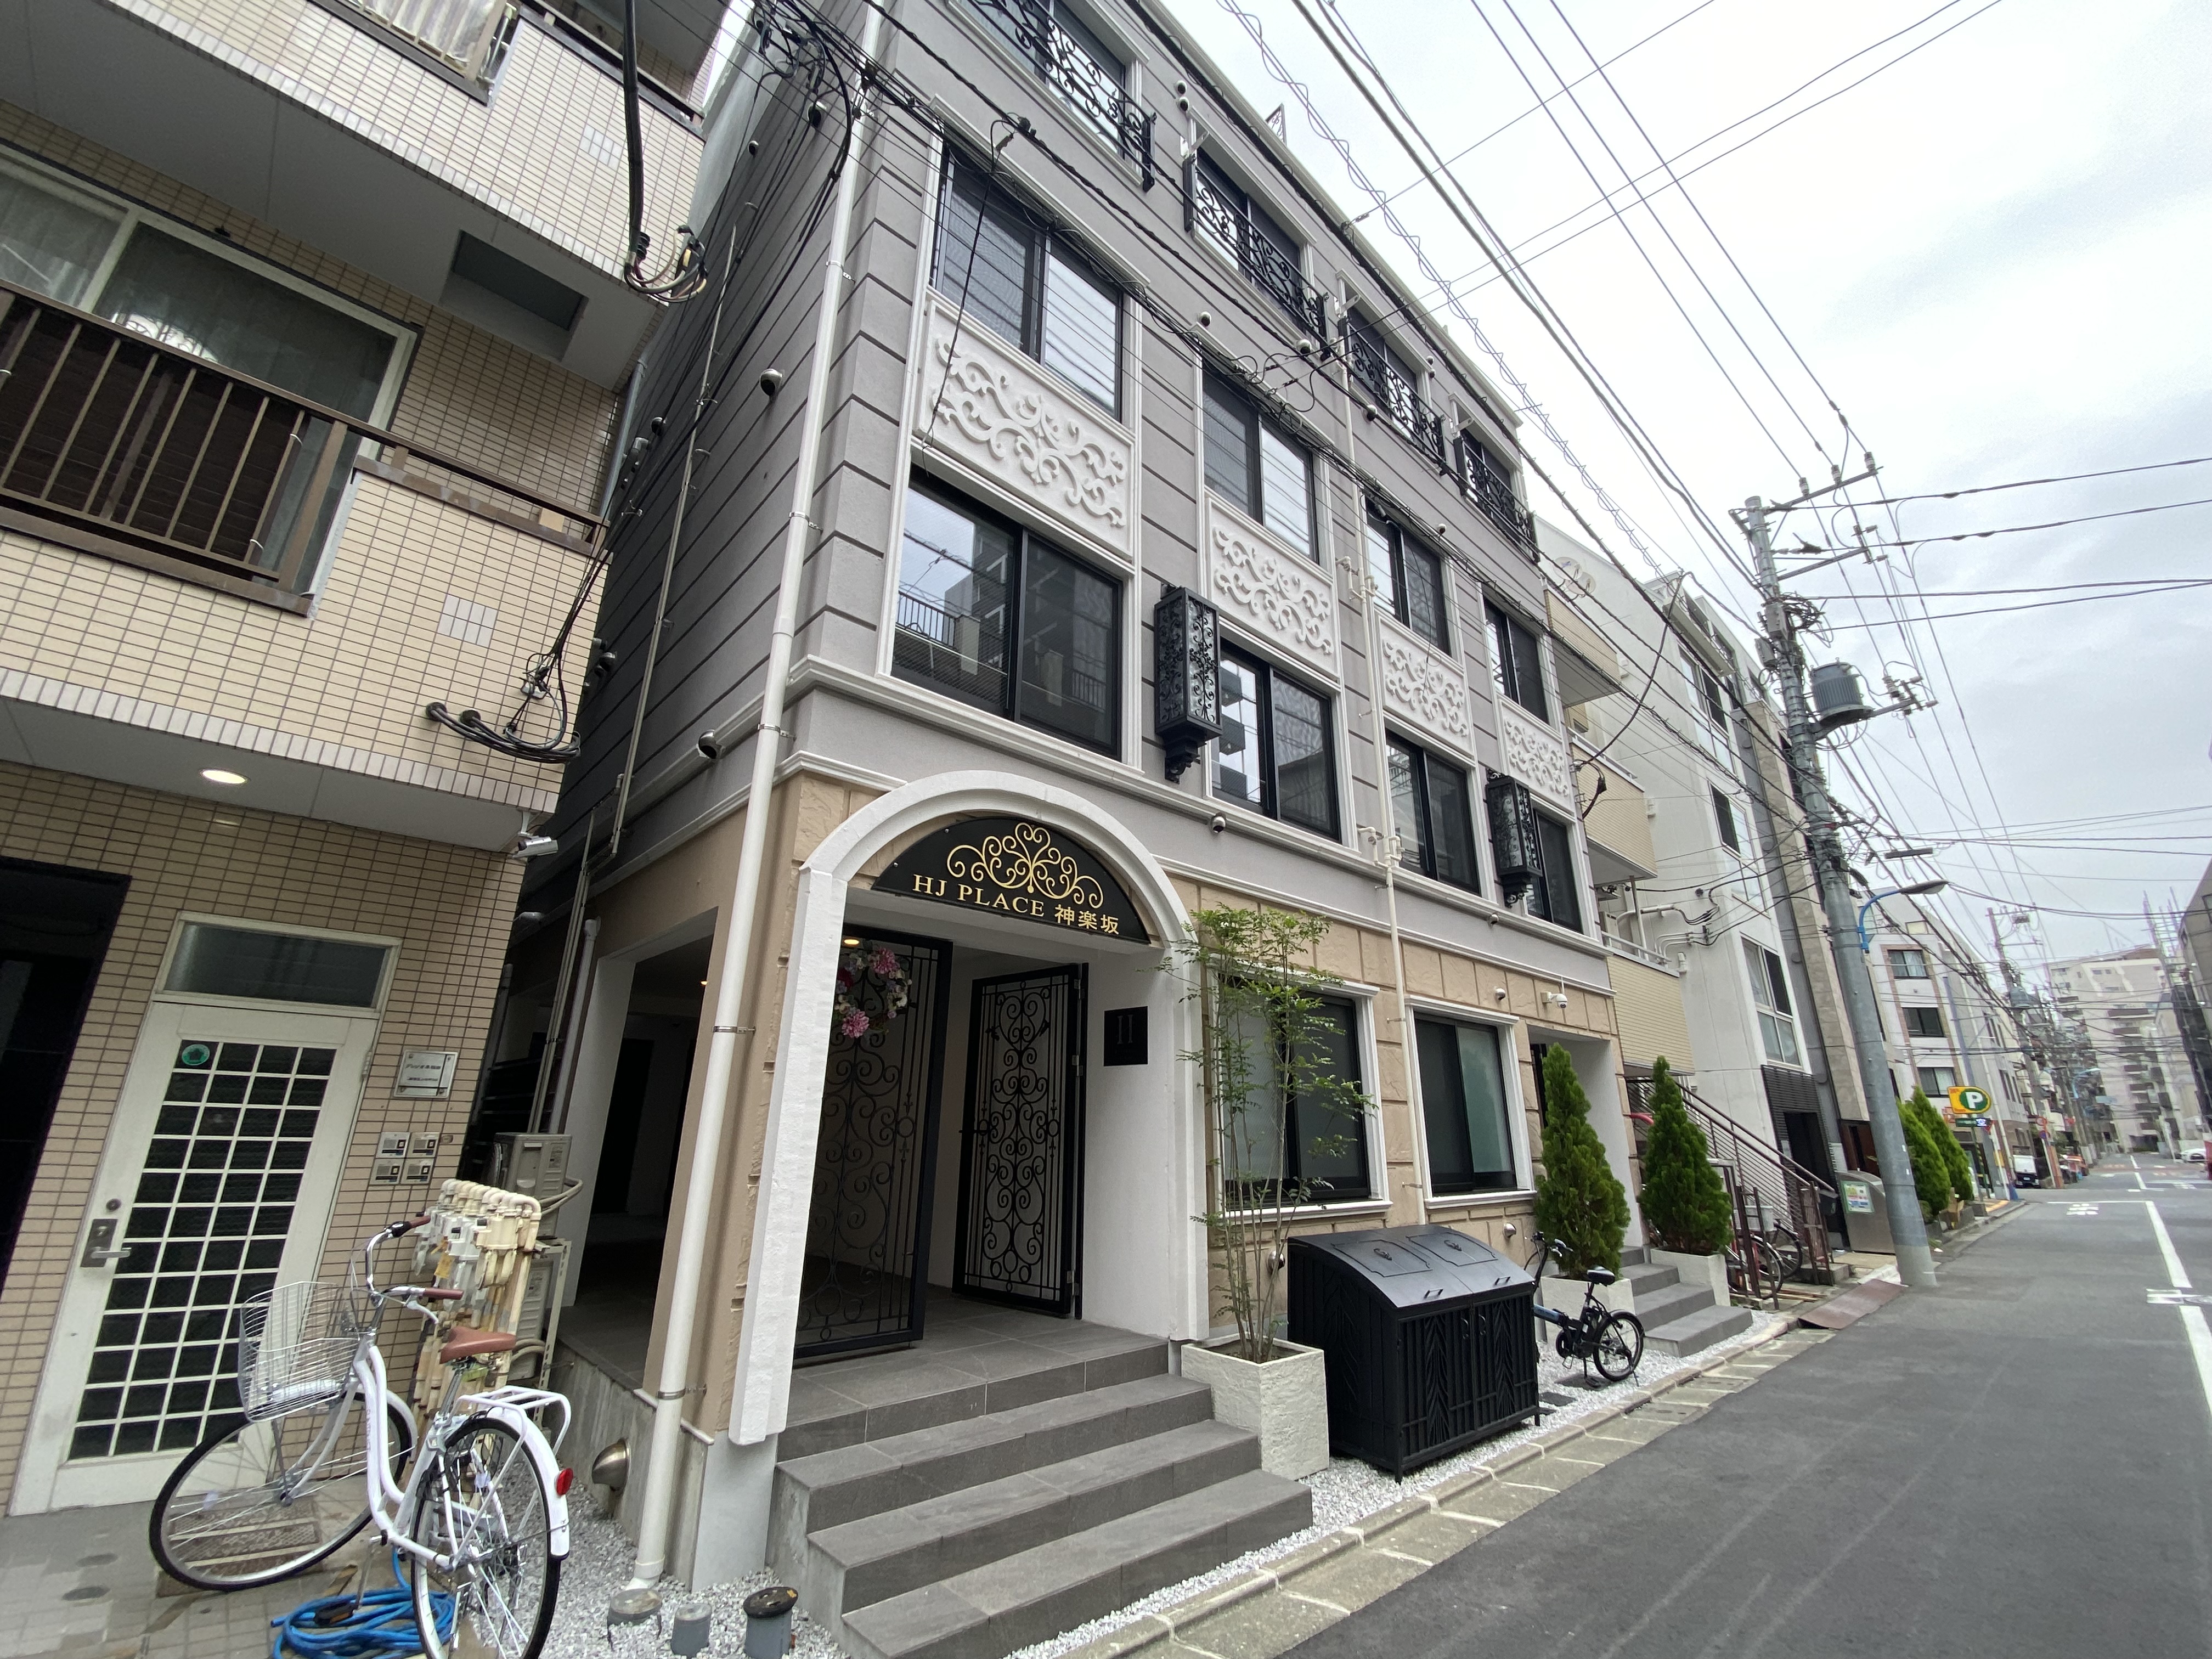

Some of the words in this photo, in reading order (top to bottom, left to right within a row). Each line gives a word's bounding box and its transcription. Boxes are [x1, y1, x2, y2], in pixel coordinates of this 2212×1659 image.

[912, 873, 947, 896] HJ
[957, 883, 1045, 917] PLACE
[1054, 904, 1119, 934] 神楽坂
[1965, 1091, 1983, 1109] P
